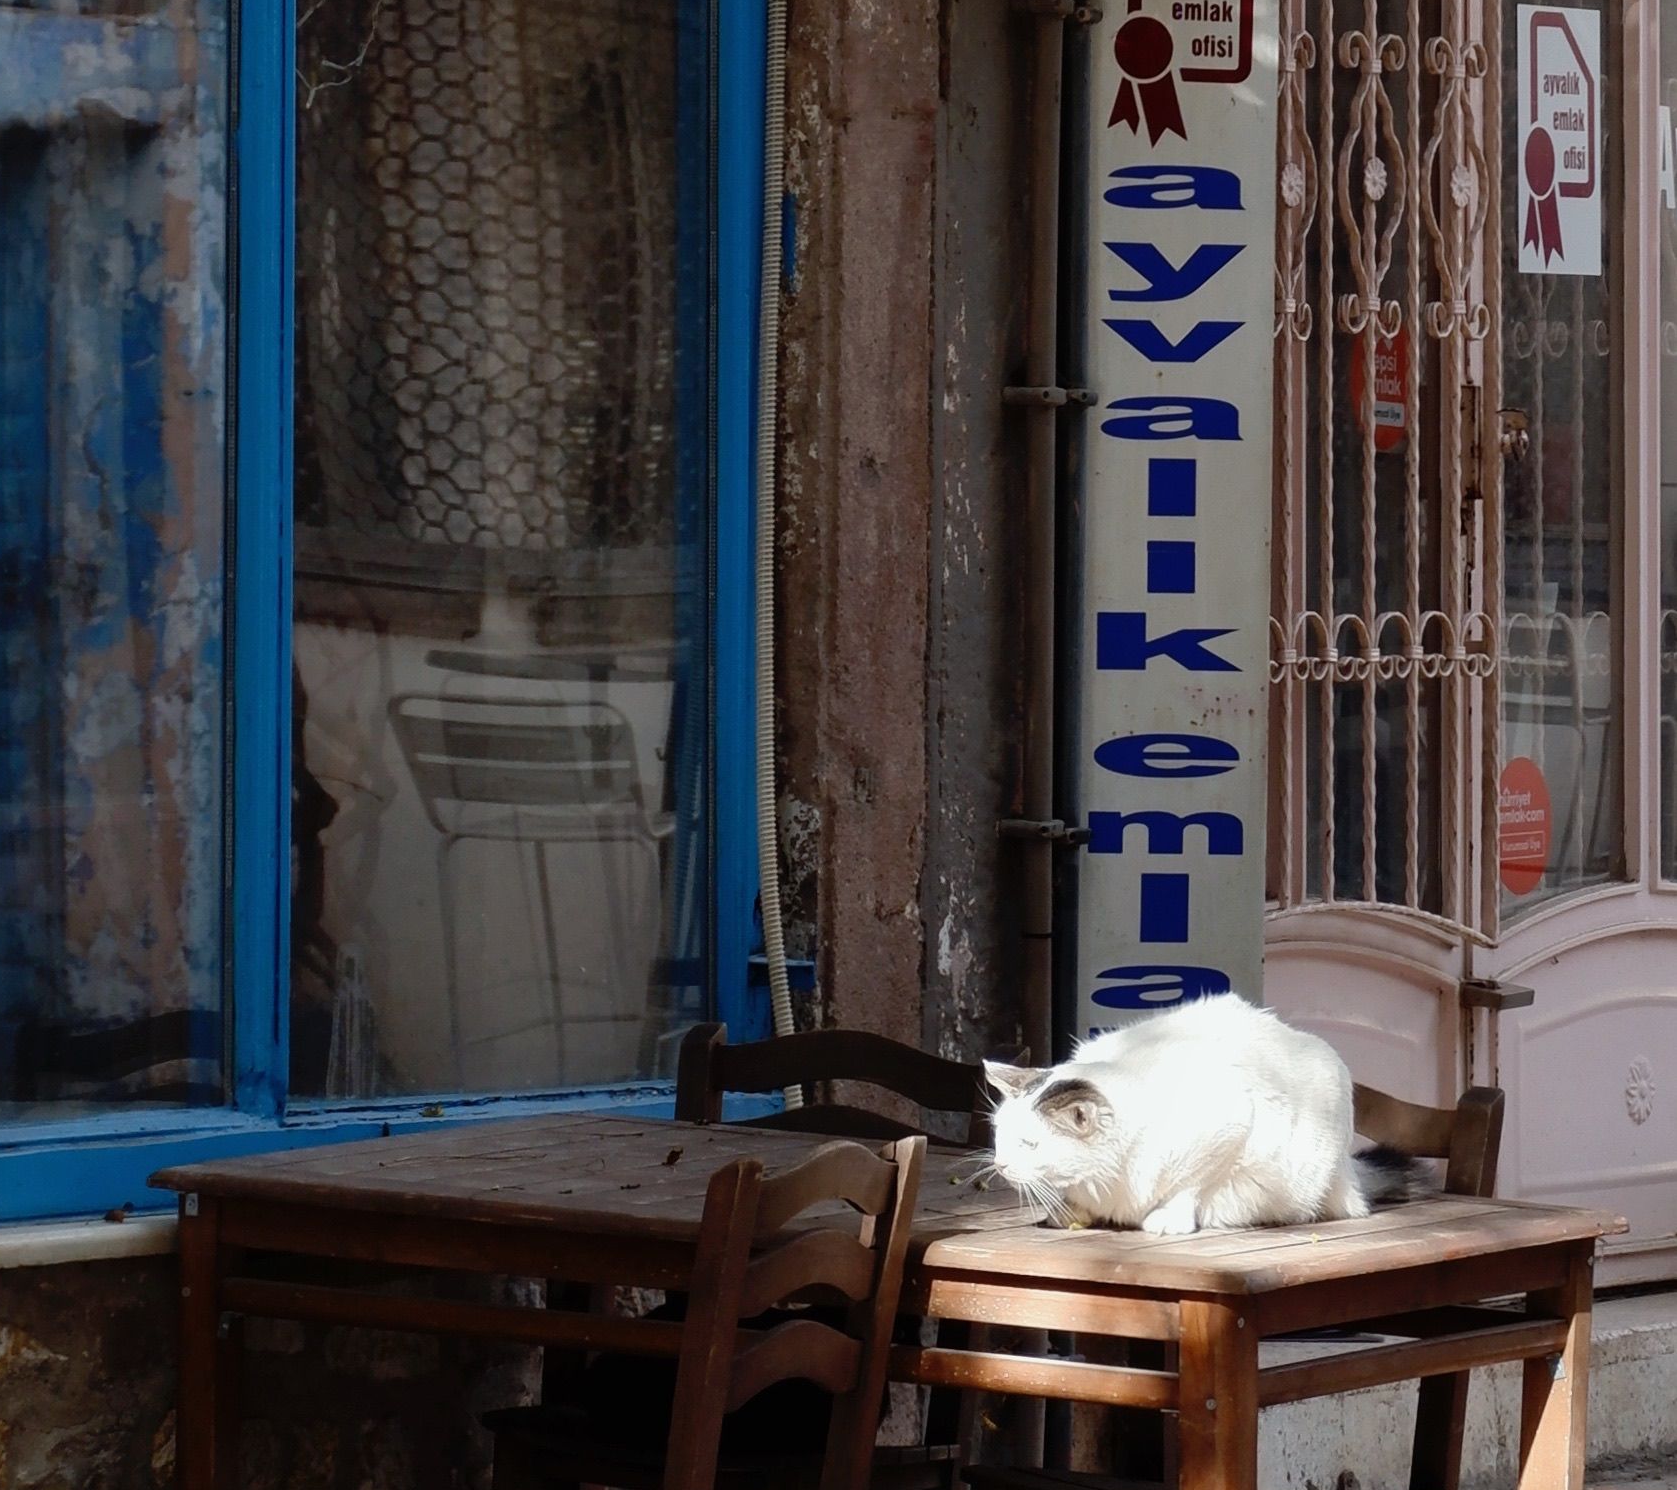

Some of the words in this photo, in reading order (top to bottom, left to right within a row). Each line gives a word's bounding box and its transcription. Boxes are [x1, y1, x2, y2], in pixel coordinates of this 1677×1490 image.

[1172, 0, 1233, 22] emlak
[1192, 35, 1233, 58] ofisi
[1543, 71, 1580, 96] ayvalık
[1553, 107, 1585, 132] emlak
[1563, 145, 1586, 170] ofisi
[1375, 350, 1397, 374] epsi
[1375, 375, 1401, 397] mlak
[1088, 733, 1244, 1038] emla
